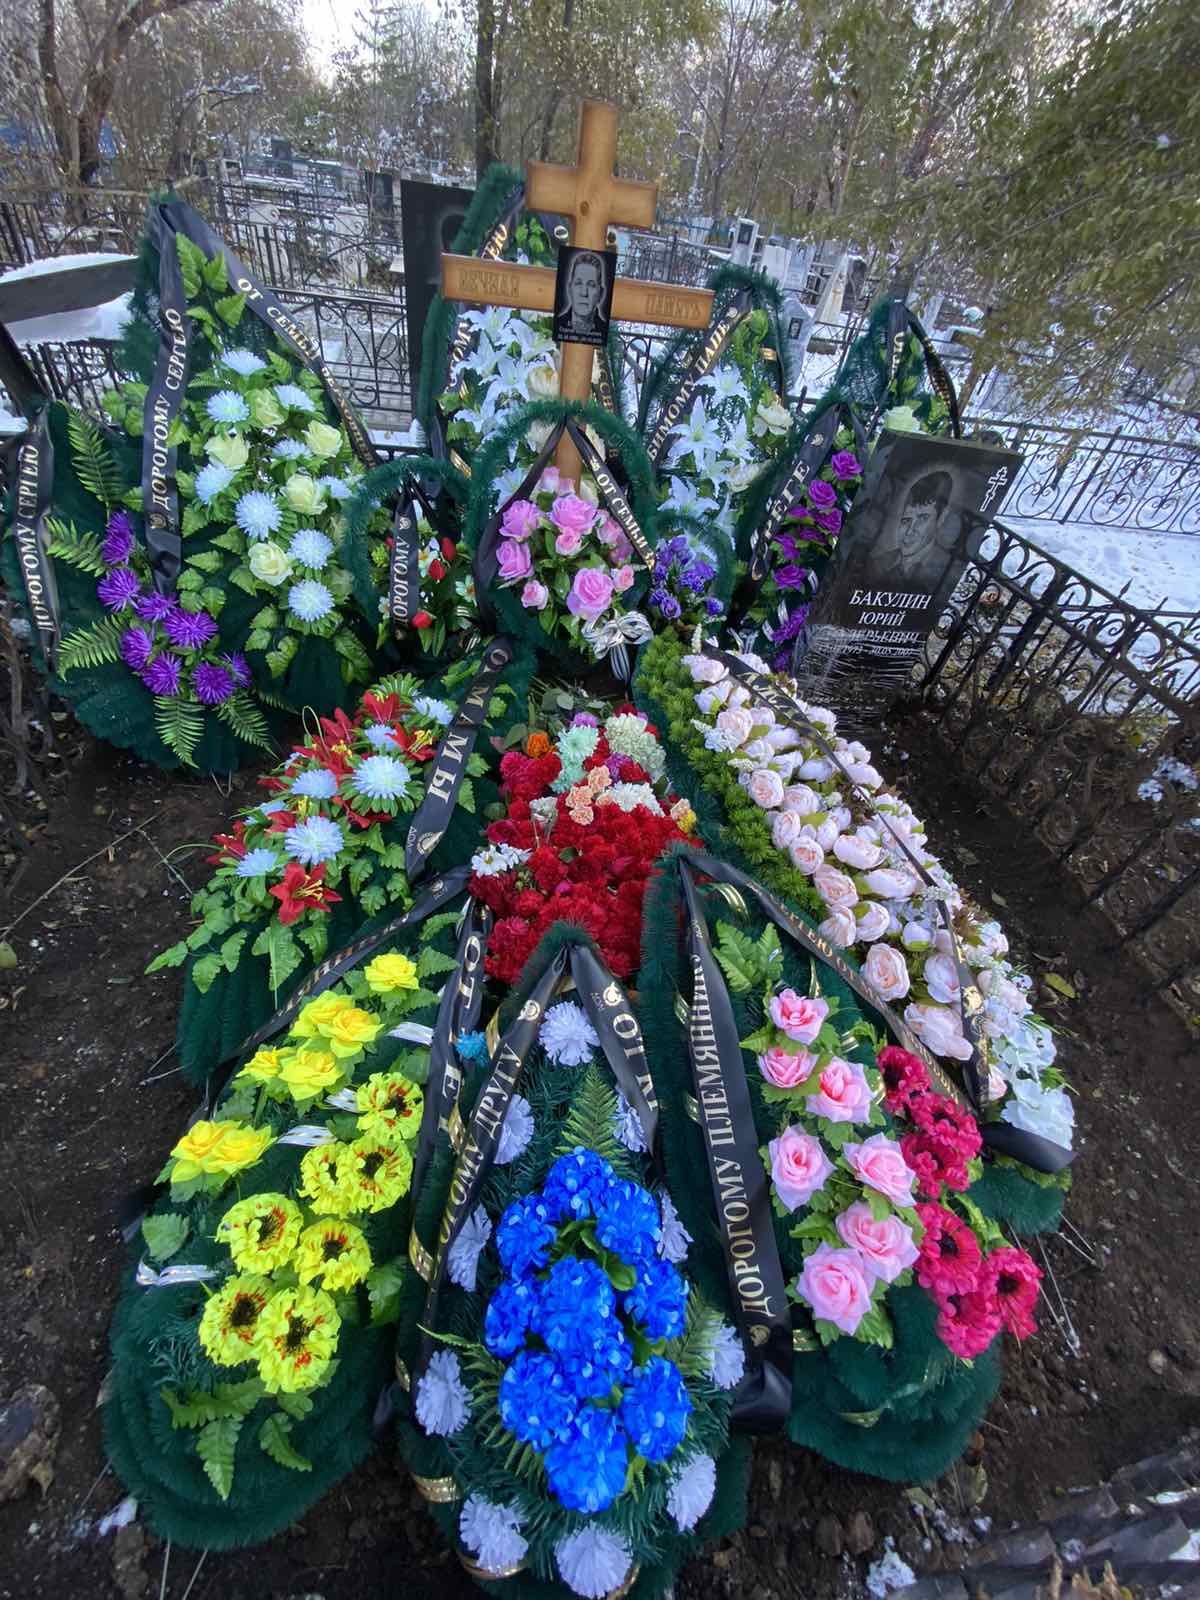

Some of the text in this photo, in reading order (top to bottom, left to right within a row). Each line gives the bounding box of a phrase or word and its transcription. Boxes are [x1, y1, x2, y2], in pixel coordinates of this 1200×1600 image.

[237, 277, 264, 302] ОТ
[694, 320, 731, 376] ПАПЕ
[151, 307, 188, 511] ДОРОГОМУ СЕРГЕЮ
[596, 473, 618, 498] ОТ
[611, 496, 648, 550] СЕМЬИ
[849, 589, 932, 610] БАКУЛИН
[858, 610, 907, 627] ЮРИЙ
[473, 1043, 522, 1140] ДРУГУ
[688, 954, 777, 1318] ДОРОГОМУ ПЛЕМЯННИКУ
